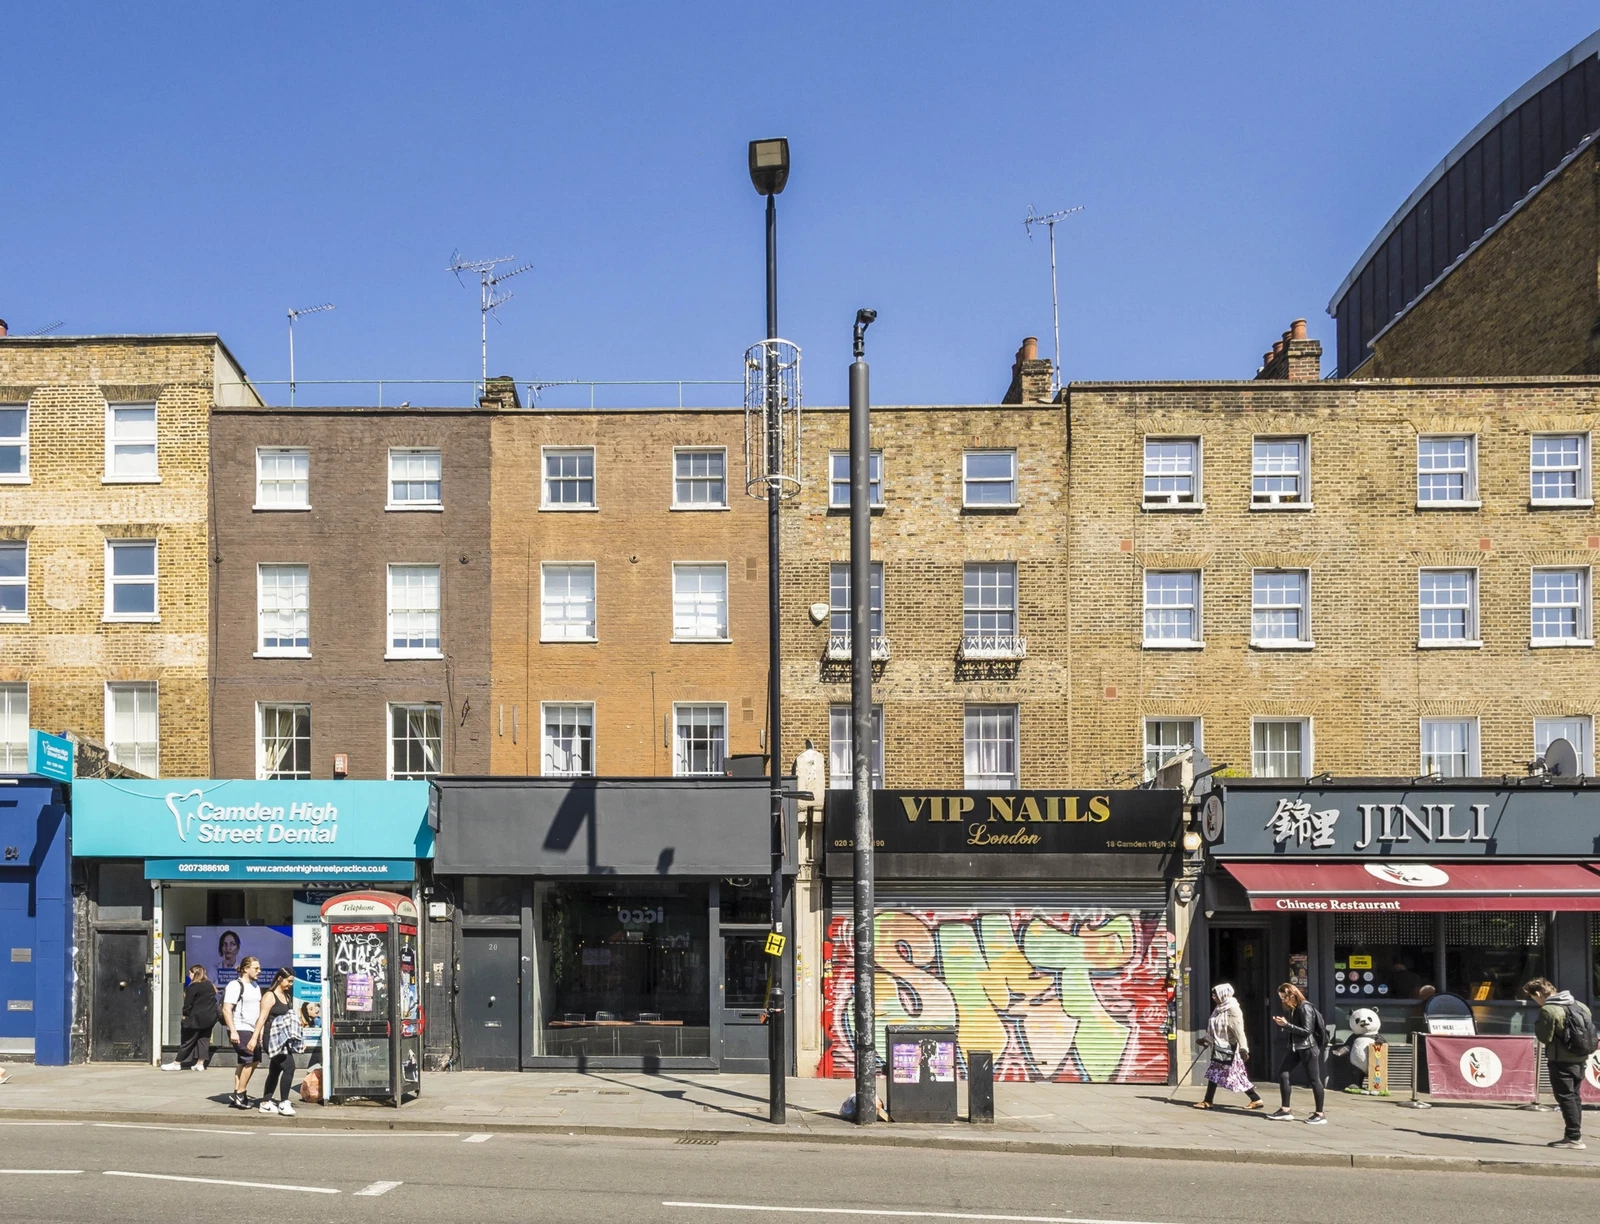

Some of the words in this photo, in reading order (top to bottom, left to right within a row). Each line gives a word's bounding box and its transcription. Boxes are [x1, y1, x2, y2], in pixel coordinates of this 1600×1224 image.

[197, 802, 285, 821] Camden
[289, 802, 338, 825] High
[899, 796, 975, 822] VIP
[987, 796, 1110, 822] NAILS
[1266, 798, 1341, 847] 錦里
[1356, 804, 1490, 848] JINLI
[198, 824, 263, 843] Street
[267, 824, 338, 843] Dental
[967, 823, 1041, 846] London
[5, 846, 19, 859] 24
[1148, 841, 1167, 849] High
[178, 864, 230, 872] 02073886108
[246, 864, 388, 874] www.camdenhighstreetpractice.co.uk
[343, 904, 376, 912] Telephone
[1276, 898, 1328, 910] Chinese
[1329, 899, 1401, 910] Restaurant
[488, 943, 498, 951] 20
